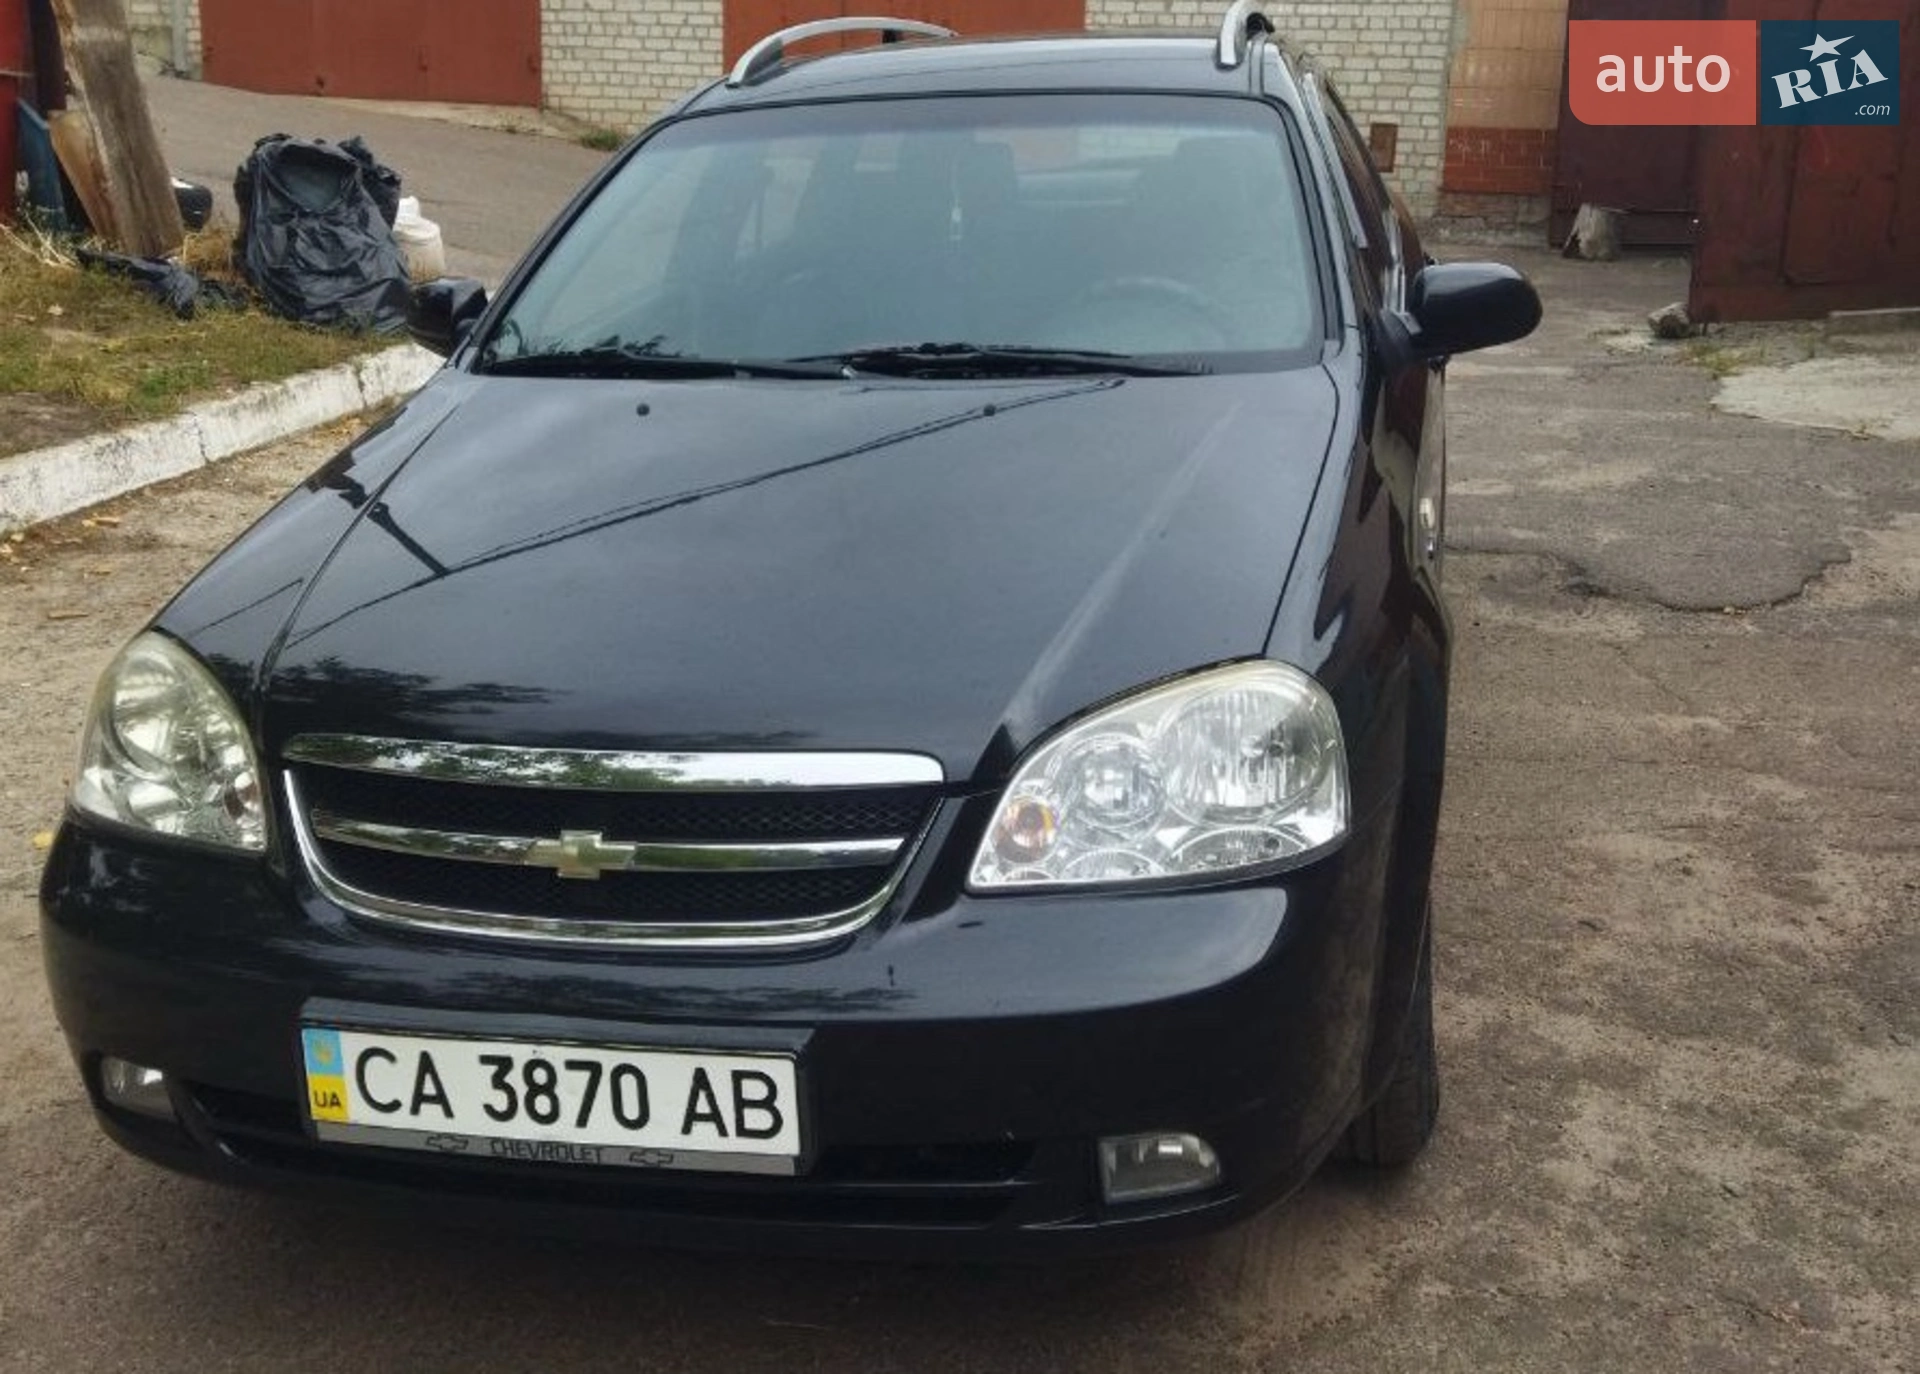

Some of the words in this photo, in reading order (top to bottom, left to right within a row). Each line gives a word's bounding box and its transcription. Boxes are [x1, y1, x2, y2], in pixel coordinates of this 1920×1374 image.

[313, 1089, 342, 1110] UA
[355, 1046, 455, 1120] CA
[478, 1054, 651, 1131] 3870
[681, 1067, 784, 1139] AB
[491, 1138, 604, 1165] CHEVROLET
